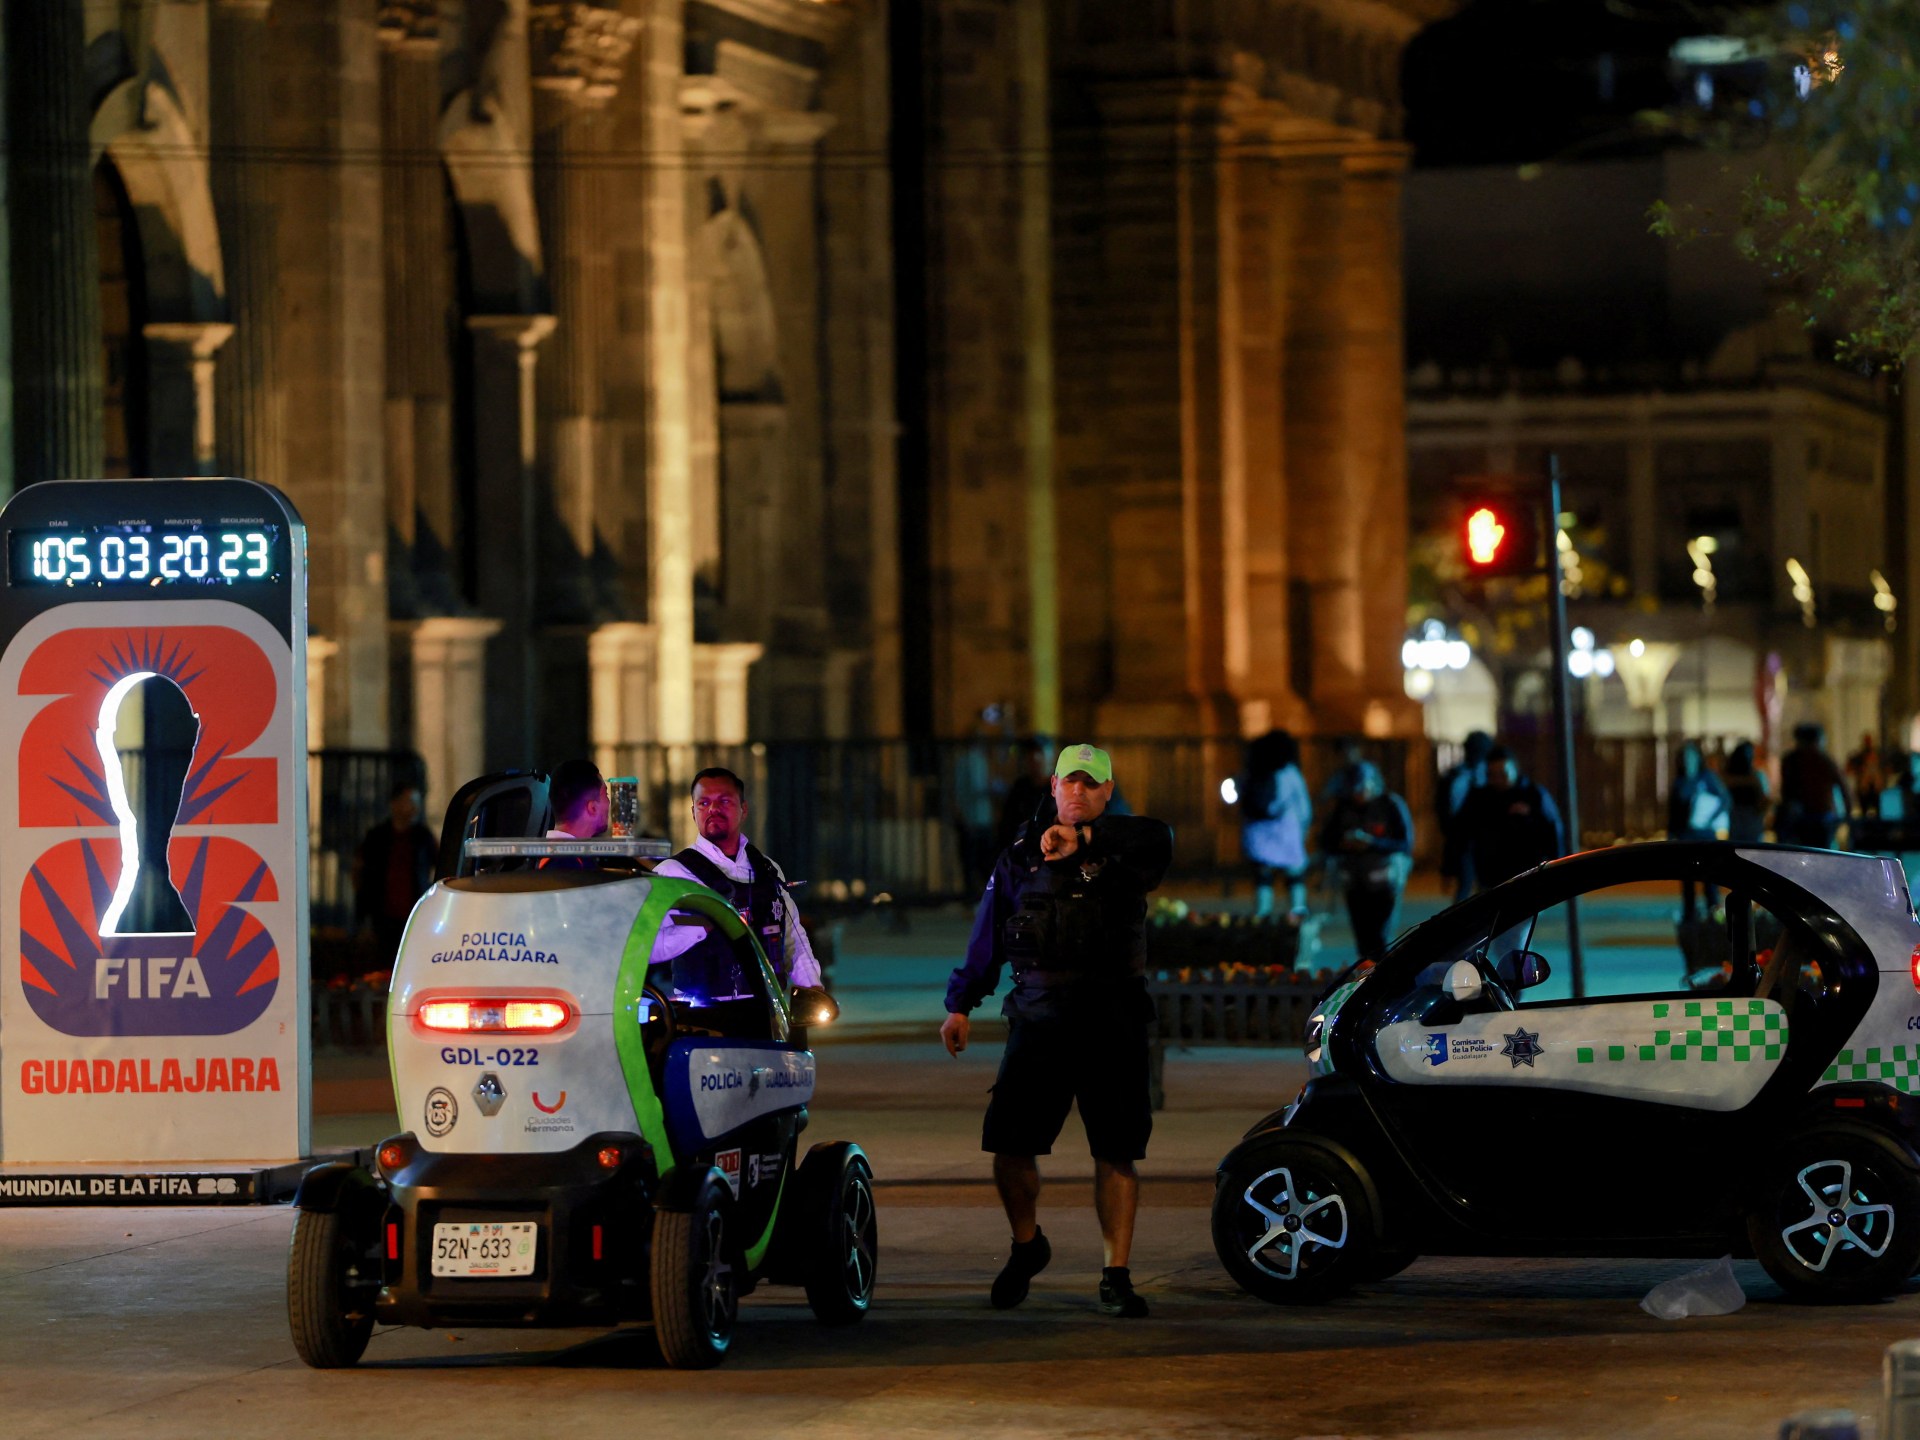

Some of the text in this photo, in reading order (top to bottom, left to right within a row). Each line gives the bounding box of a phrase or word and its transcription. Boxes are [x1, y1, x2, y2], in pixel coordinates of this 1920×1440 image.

[33, 533, 268, 580] 105 03 20 23
[461, 932, 527, 947] POLICIA
[431, 948, 559, 964] GUADALAJARA
[95, 957, 211, 999] FIFA
[441, 1047, 539, 1066] GDL-022
[20, 1057, 280, 1095] GUADALAJARA
[766, 1071, 813, 1088] GUADALAJARA
[524, 1125, 574, 1133] Hermanos
[527, 1116, 571, 1125] Ciudades
[0, 1178, 236, 1196] MUNDIAL DE LA FIFA 26
[438, 1238, 511, 1259] 52N-633
